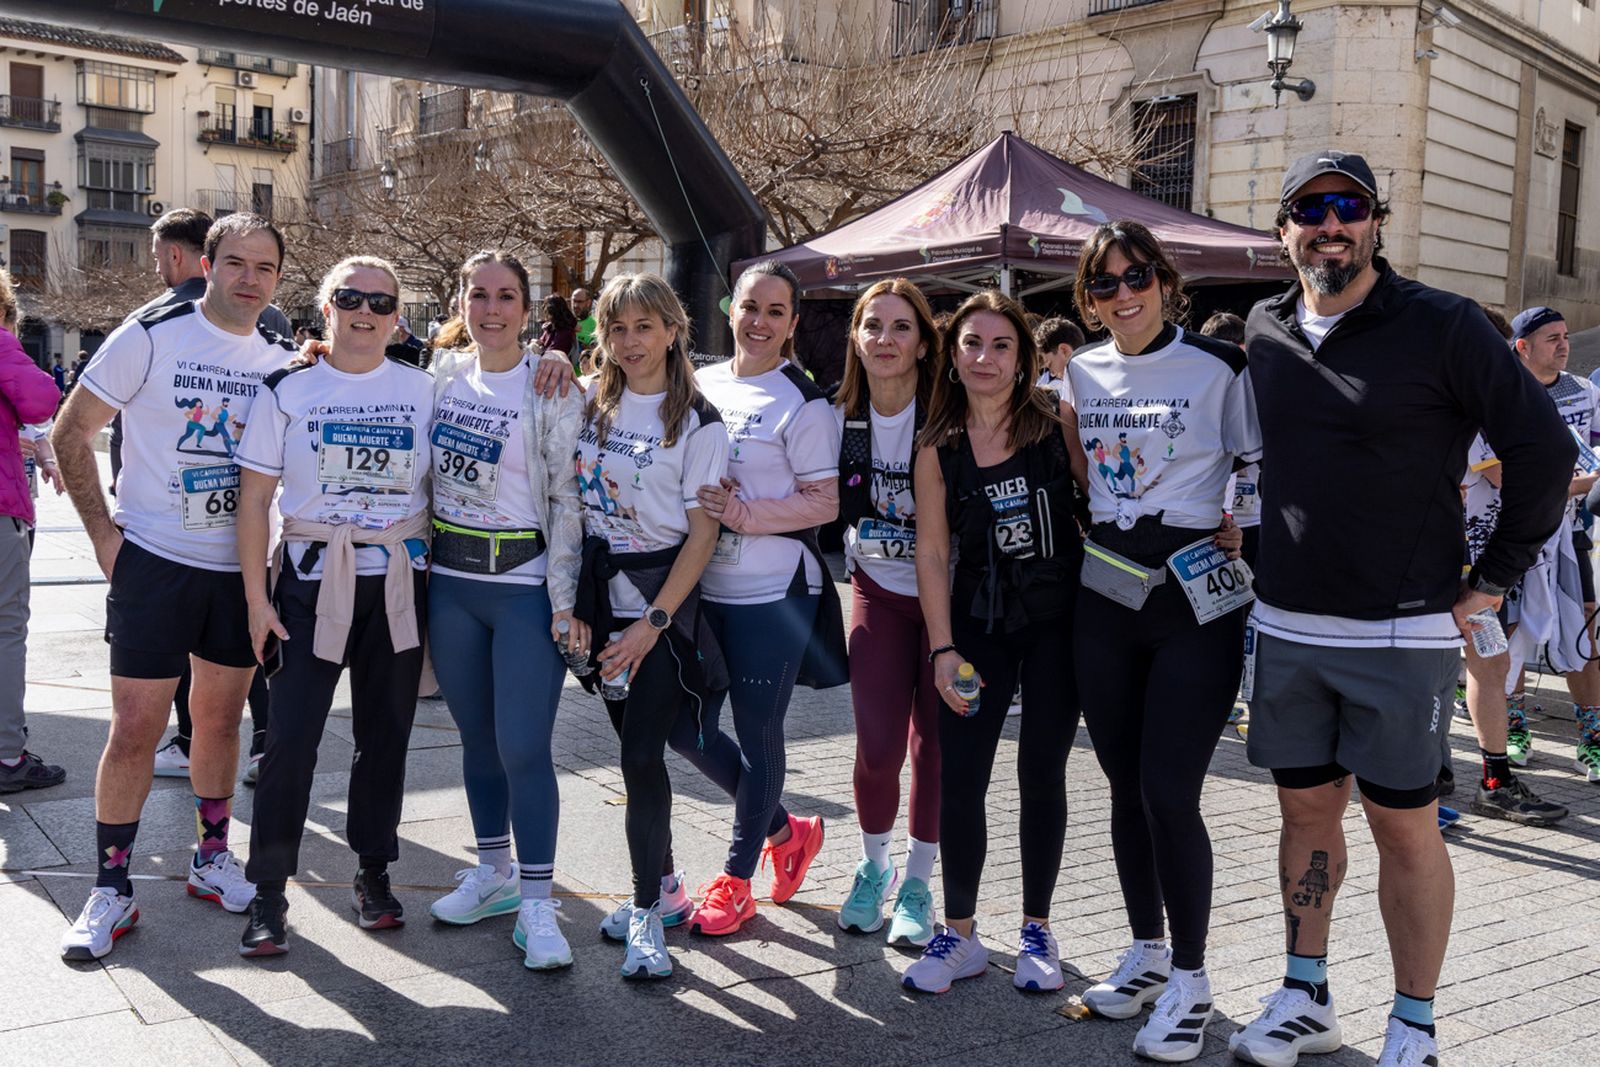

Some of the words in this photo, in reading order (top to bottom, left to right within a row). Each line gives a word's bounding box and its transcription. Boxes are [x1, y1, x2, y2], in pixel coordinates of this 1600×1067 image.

[293, 0, 319, 16] de
[324, 1, 372, 25] Jaén
[177, 361, 187, 370] VI
[189, 362, 231, 377] CARRERA
[174, 375, 213, 392] BUENA
[308, 406, 318, 416] VI
[319, 405, 366, 416] CARRERA
[367, 403, 417, 413] CAMINATA
[1081, 399, 1089, 408] VI
[1089, 398, 1133, 408] CARRERA
[1136, 398, 1190, 409] CAMINATA
[476, 404, 519, 420] CAMINATA
[455, 412, 494, 433] MUERTE
[1113, 413, 1161, 429] MUERTE
[341, 425, 370, 433] CARRERA
[371, 427, 405, 436] CAMINATA
[332, 433, 357, 444] BUENA
[360, 435, 390, 447] MUERTE
[437, 434, 456, 449] BUENA
[456, 441, 480, 457] MUERTE
[345, 446, 391, 472] 129
[439, 450, 479, 482] 396
[192, 479, 219, 491] BUENA
[220, 475, 240, 486] MUER
[205, 489, 241, 515] 68
[868, 529, 892, 539] BUENA
[1187, 558, 1211, 576] BUENA
[1206, 562, 1245, 597] 406
